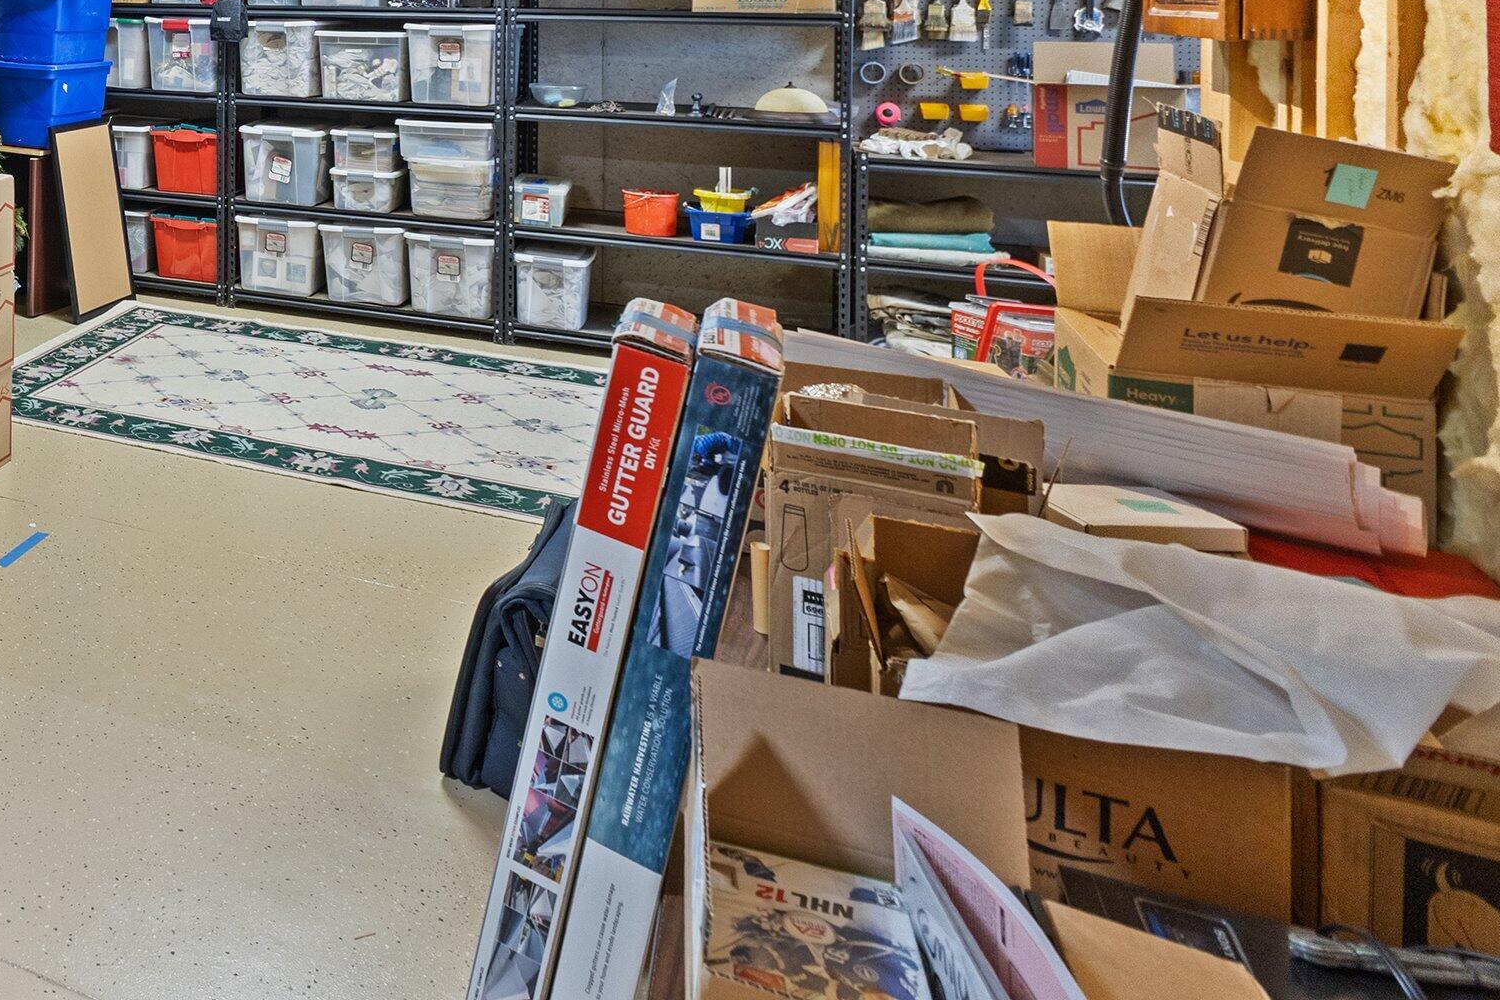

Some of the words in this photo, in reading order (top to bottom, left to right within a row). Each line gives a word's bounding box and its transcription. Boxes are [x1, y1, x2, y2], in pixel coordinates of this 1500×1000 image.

[1080, 105, 1105, 113] LOWE
[1182, 327, 1220, 340] Let
[1226, 333, 1252, 344] us
[1259, 335, 1315, 351] help.
[1125, 386, 1176, 405] Heavy
[612, 386, 630, 433] Micro-Mesh
[607, 433, 619, 455] Steel
[607, 442, 642, 526] GUTTER
[627, 366, 660, 441] GUARD
[648, 437, 661, 452] Kit
[813, 433, 846, 448] OPEN
[852, 439, 875, 450] NOT
[644, 452, 660, 470] DIY
[598, 455, 614, 493] Stainless
[779, 479, 791, 495] 4
[792, 485, 819, 496] BOTTLES
[567, 561, 603, 648] EASYON
[658, 687, 674, 730] SOLUTION
[621, 778, 639, 827] RAINWATER
[633, 720, 652, 777] HARVESTING
[647, 710, 655, 720] IS
[651, 674, 664, 702] VIABLE
[641, 733, 663, 794] CONSERVATION
[635, 793, 649, 824] WATER
[1048, 833, 1190, 879] BEAUTY
[605, 883, 616, 906] damage
[755, 884, 788, 904] 12
[602, 906, 610, 922] water
[790, 891, 854, 920] NHL
[591, 950, 600, 972] gutters
[600, 963, 608, 981] home
